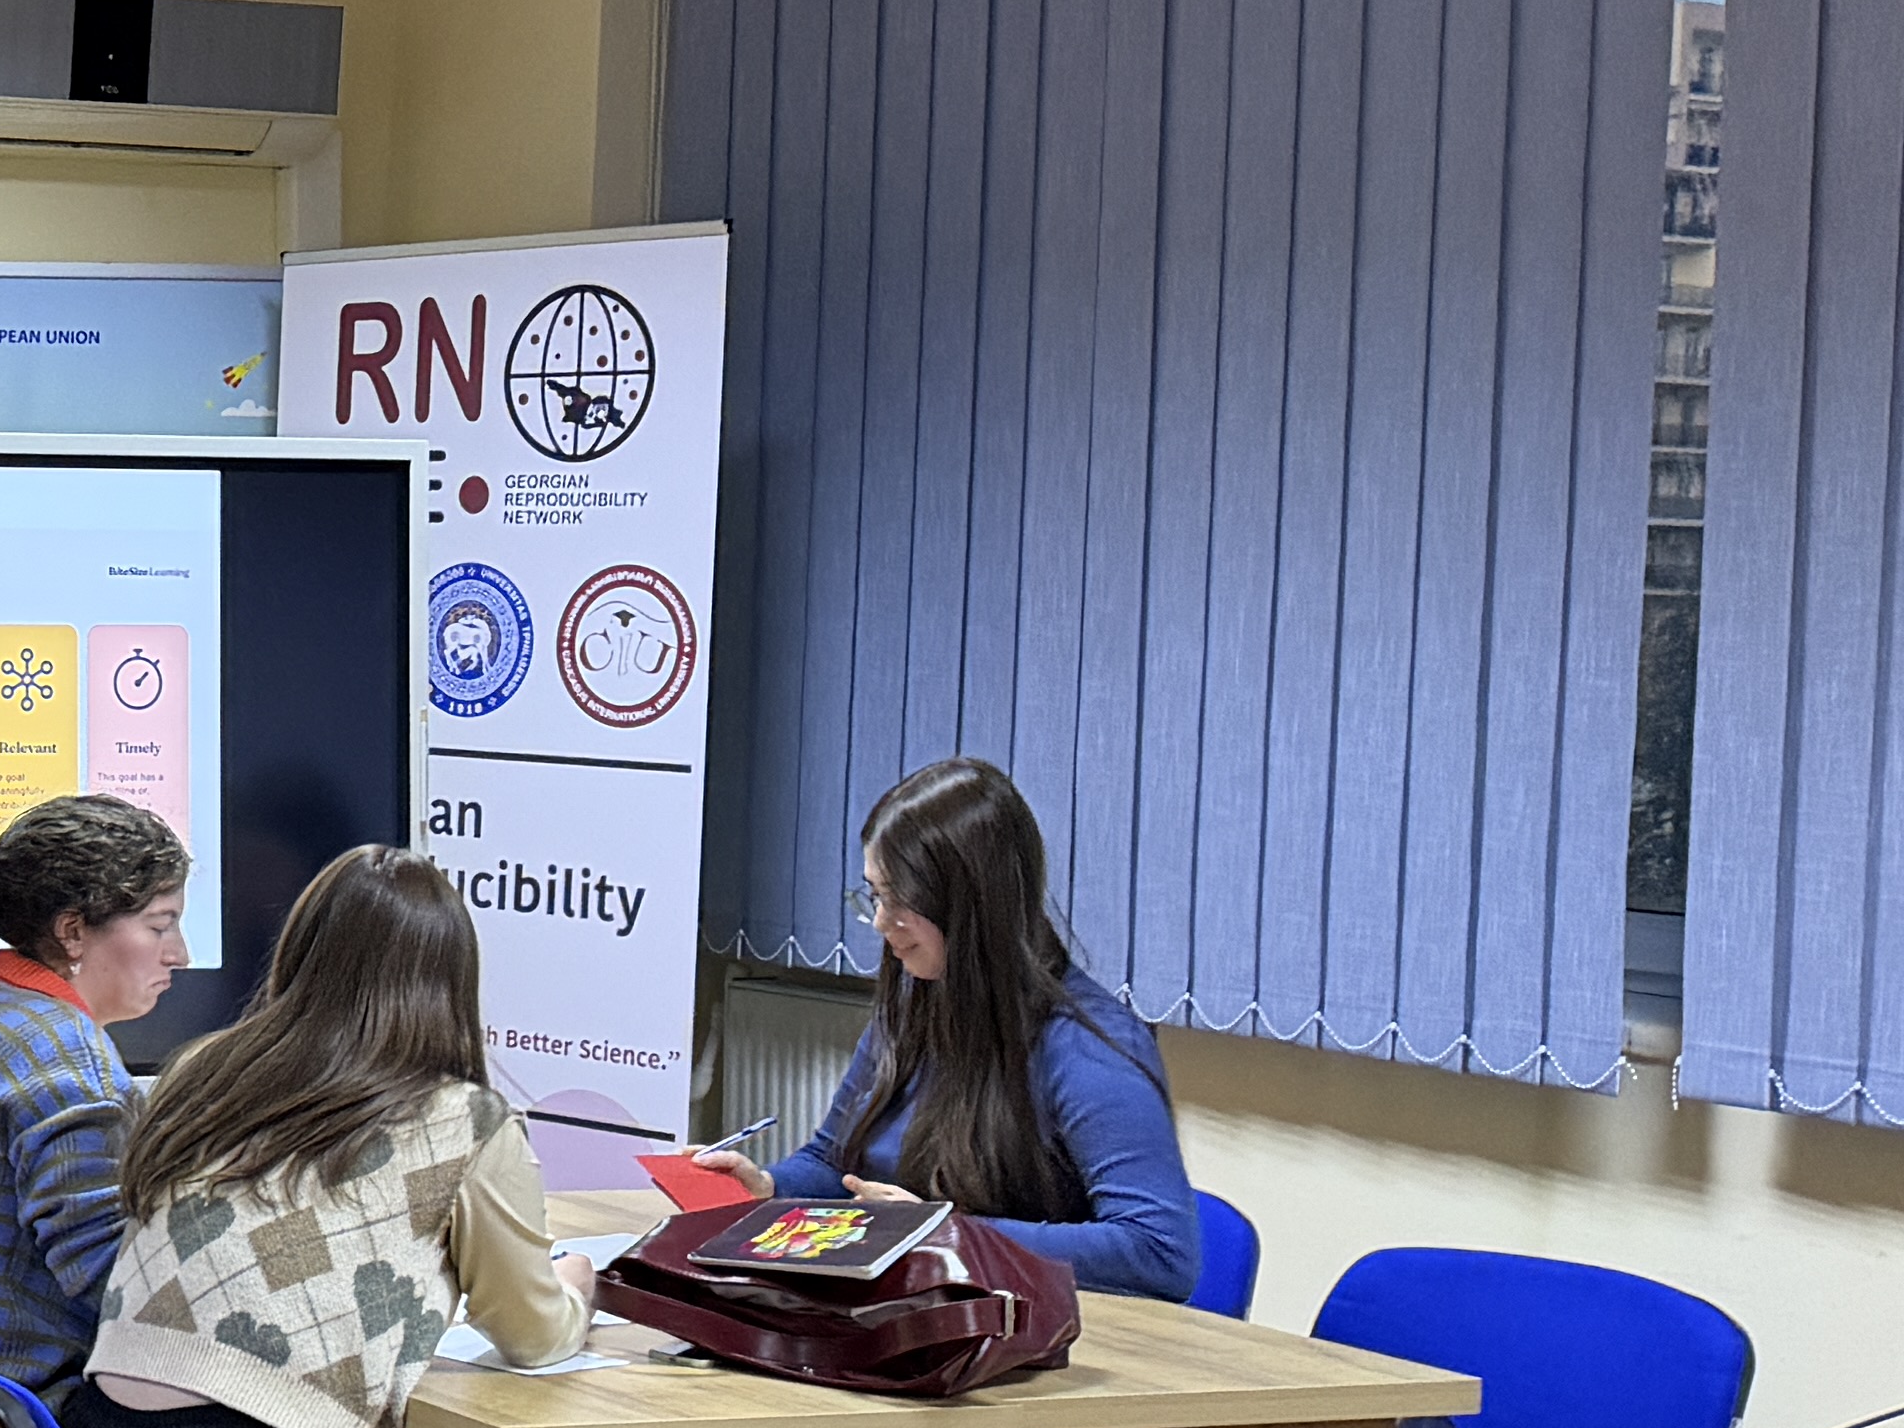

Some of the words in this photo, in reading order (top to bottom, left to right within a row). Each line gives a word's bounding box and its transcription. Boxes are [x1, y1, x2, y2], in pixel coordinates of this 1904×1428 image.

[46, 329, 100, 344] UNION
[504, 474, 589, 489] GEORGIAN
[504, 492, 648, 507] REPRODUCIBILITY
[503, 510, 583, 525] NETWORK
[115, 741, 162, 756] Timely
[6, 773, 25, 783] goal
[97, 772, 116, 781] This
[118, 773, 137, 783] goal
[428, 855, 646, 937] ucibility
[505, 1029, 573, 1056] Better
